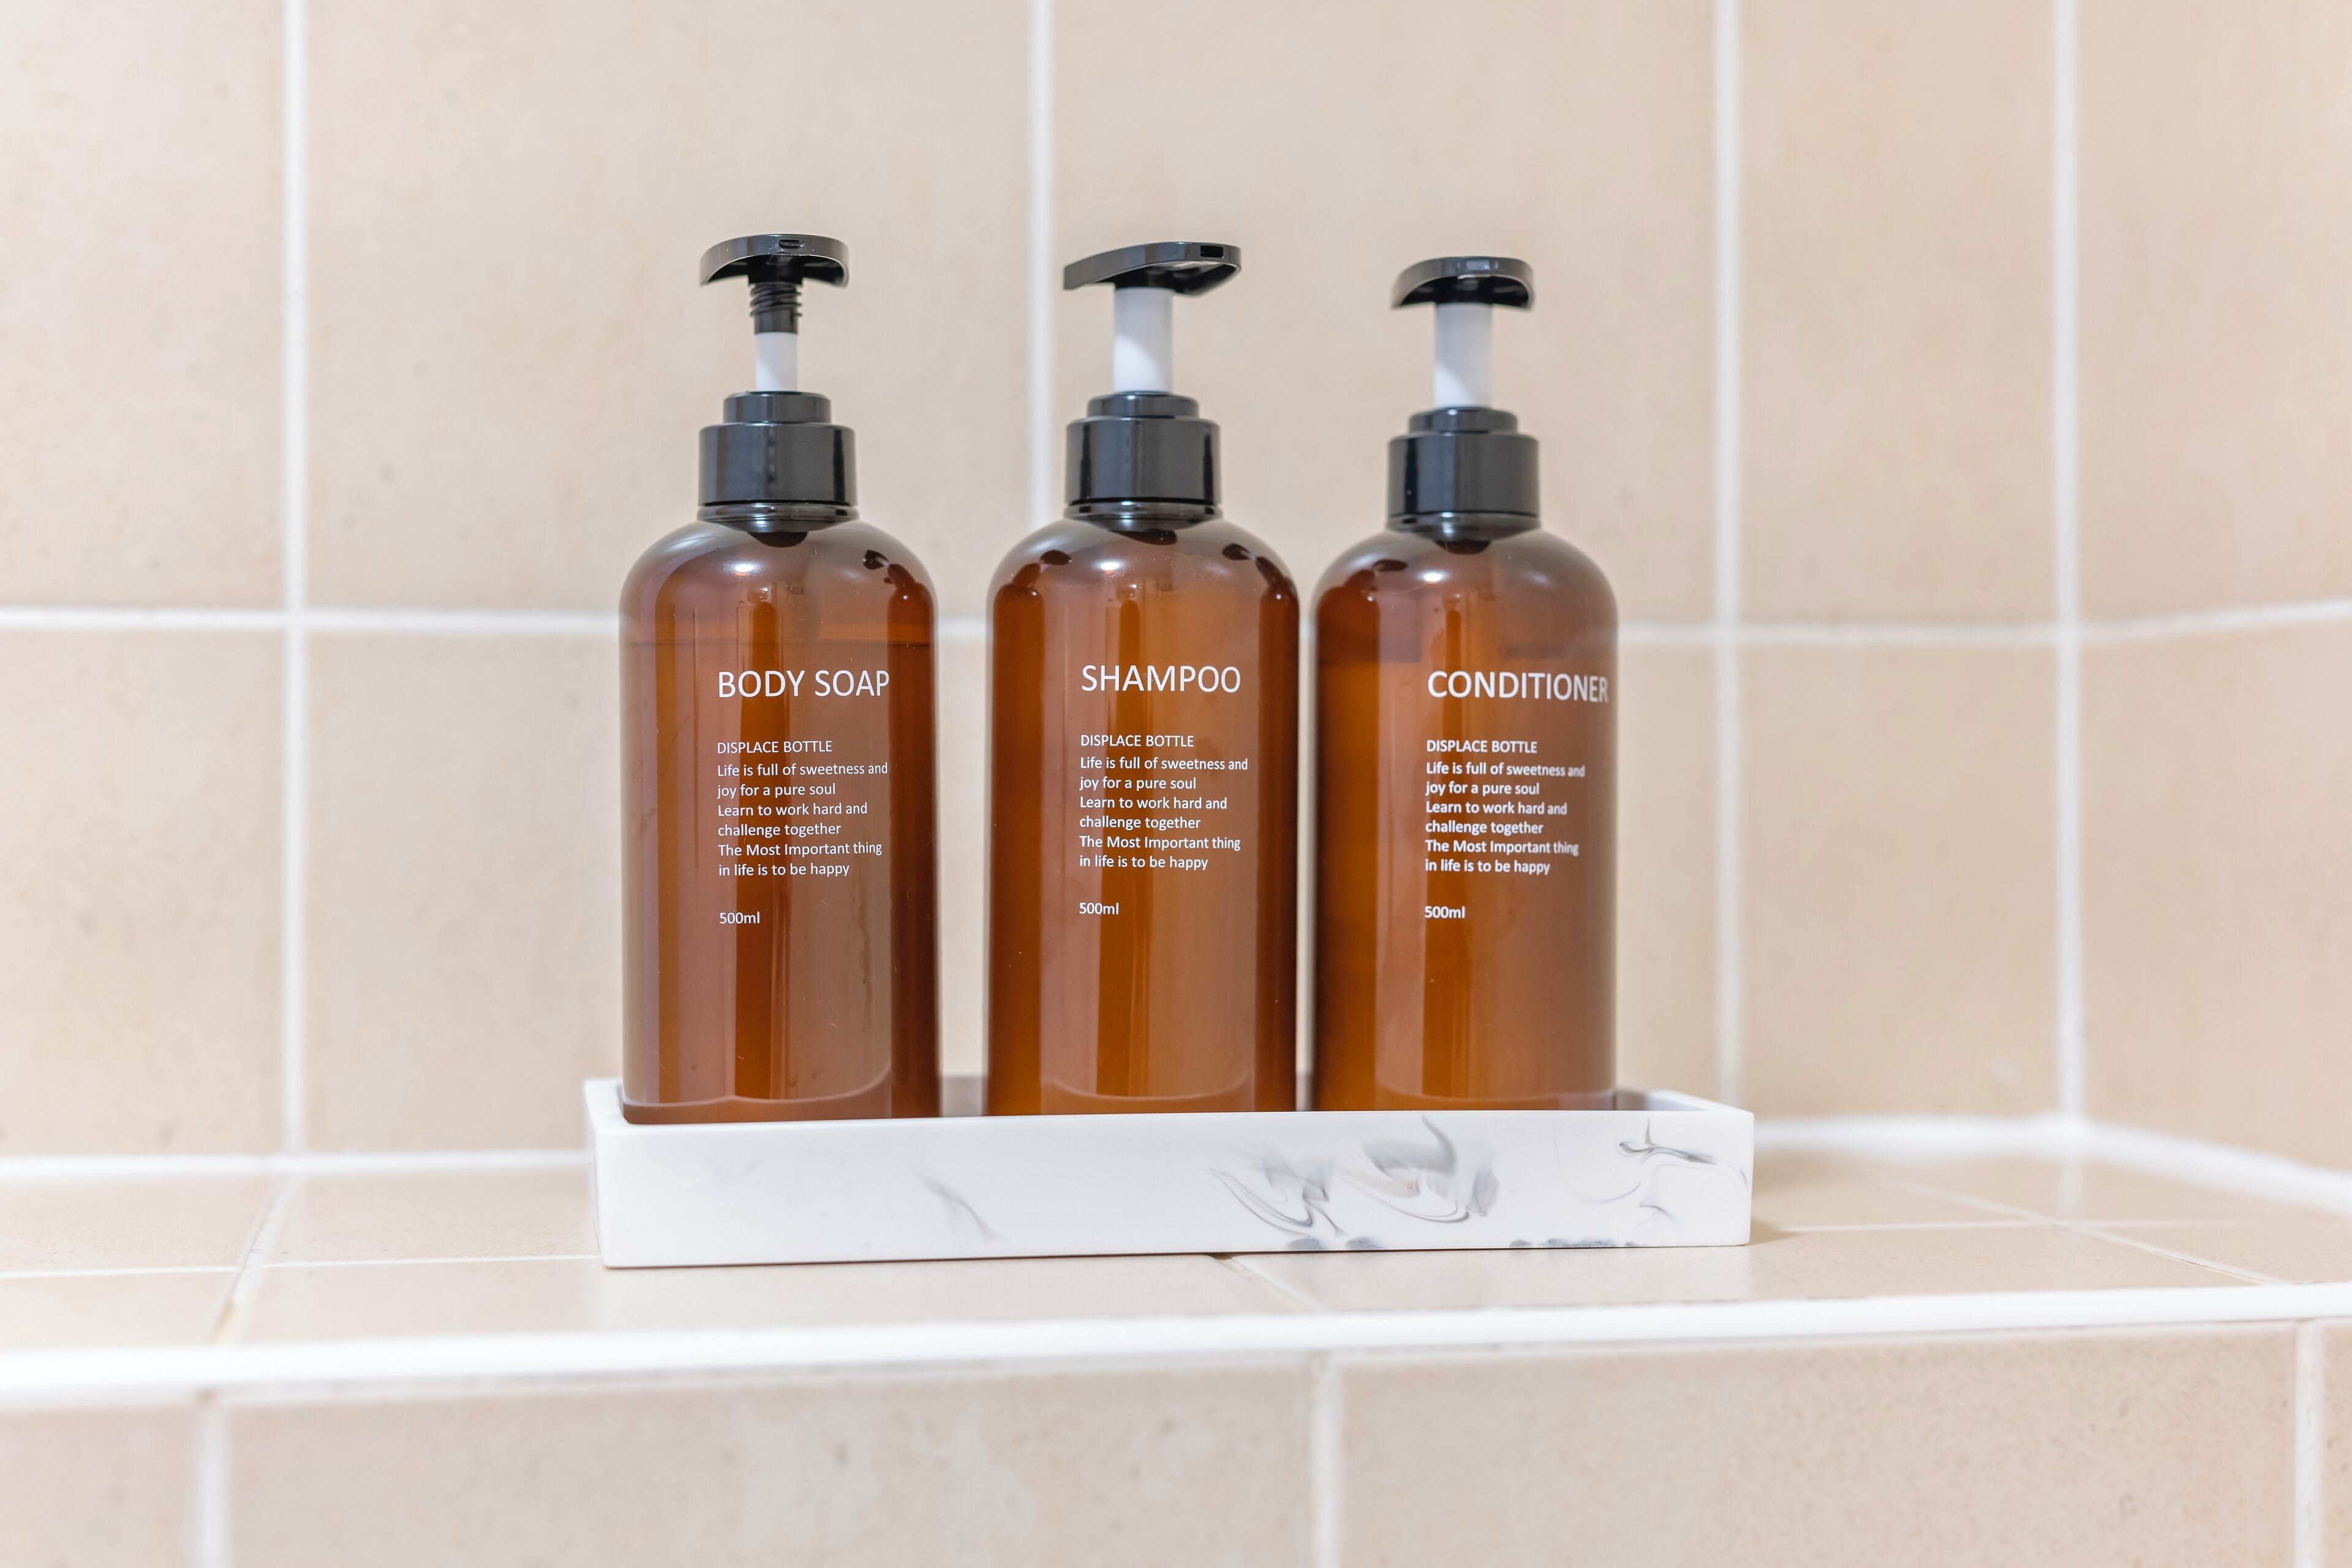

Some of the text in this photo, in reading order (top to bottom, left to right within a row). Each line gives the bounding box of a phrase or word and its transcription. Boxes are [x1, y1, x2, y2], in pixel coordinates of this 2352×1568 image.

[718, 669, 889, 698] BODY SOAP
[1082, 665, 1241, 693] SHAMPOO
[1428, 670, 1608, 704] CONDITIONER
[717, 740, 832, 754] DISPLACE BOTTLE
[1081, 734, 1194, 747] DISPLACE BOTTLE
[1427, 739, 1537, 754] DISPLACE BOTTLE
[717, 761, 888, 777] Life is full of sweetness and
[1080, 756, 1248, 771] Life is full of sweetness and
[1426, 761, 1586, 778] Life is full of sweetness and
[717, 782, 835, 799] joy for a pure soul
[1079, 775, 1196, 791] joy for a pure soul
[1425, 780, 1540, 797] joy for a pure soul
[718, 802, 867, 816] Learn to work hard and
[1080, 796, 1227, 809] Learn to work hard and
[1426, 801, 1568, 815] Learn to work hard and
[718, 822, 842, 838] challenge together
[1079, 815, 1201, 831] challenge together
[1425, 820, 1544, 836] challenge together
[717, 841, 882, 858] The Most Important thing
[1079, 835, 1241, 851] The Most Important thing
[1425, 839, 1579, 857] The Most Important thing
[718, 862, 850, 876] in life is to be happy
[1079, 854, 1208, 870] in life is to be happy
[1425, 858, 1550, 875] in life is to be happy
[1079, 902, 1119, 915] 500ml
[1424, 905, 1466, 919] 500ml
[720, 911, 760, 924] 500ml
